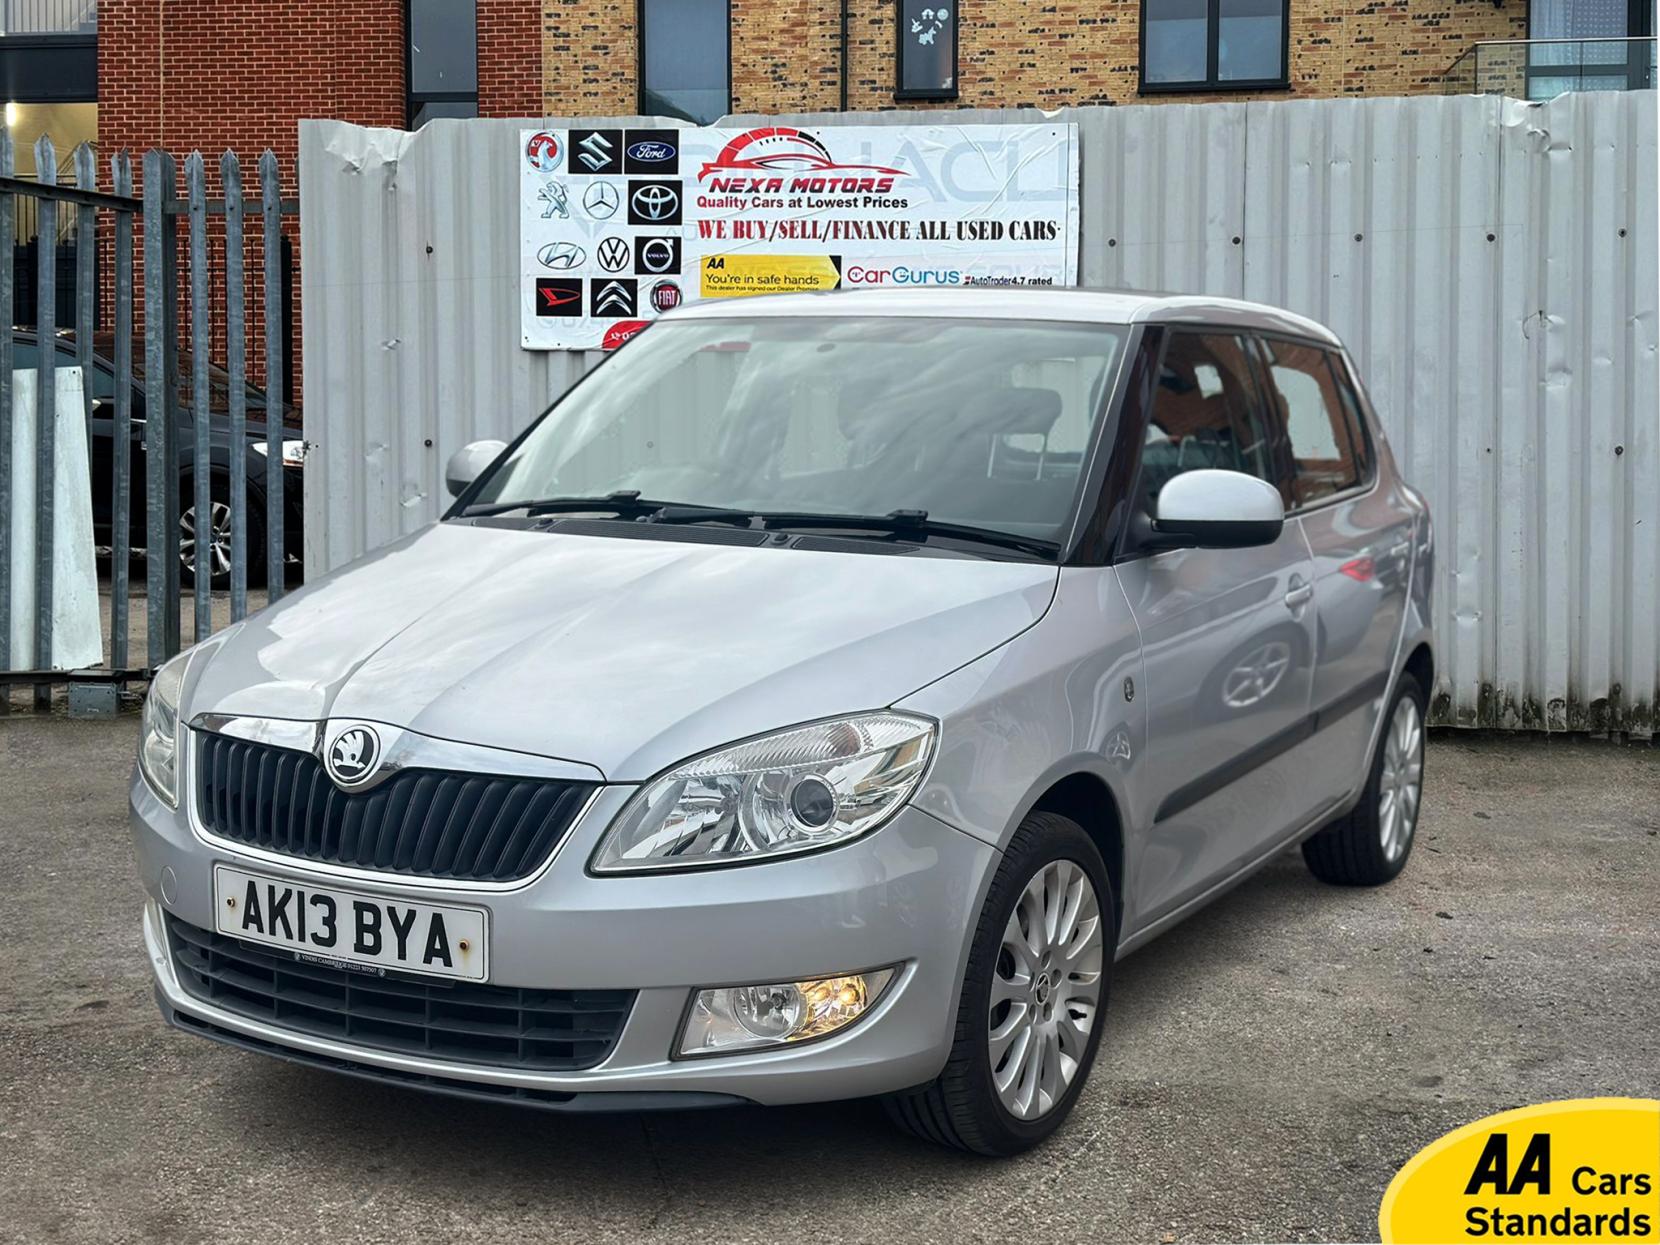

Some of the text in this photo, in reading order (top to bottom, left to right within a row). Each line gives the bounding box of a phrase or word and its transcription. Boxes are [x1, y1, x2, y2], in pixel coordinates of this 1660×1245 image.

[636, 144, 666, 158] Ford
[709, 178, 895, 193] NEXA MOTORS
[697, 196, 909, 210] Quality Cars at Lowest Prices
[697, 220, 726, 240] WE
[732, 220, 911, 243] BUY/SELL/FINANCE
[916, 220, 951, 240] ALL
[956, 220, 1004, 240] USED
[706, 257, 725, 269] AA
[706, 273, 819, 285] You're in safe hands
[847, 266, 960, 284] CarGurus
[1028, 277, 1053, 286] rated
[658, 290, 677, 305] FIAT
[242, 880, 453, 968] AK13 BYA
